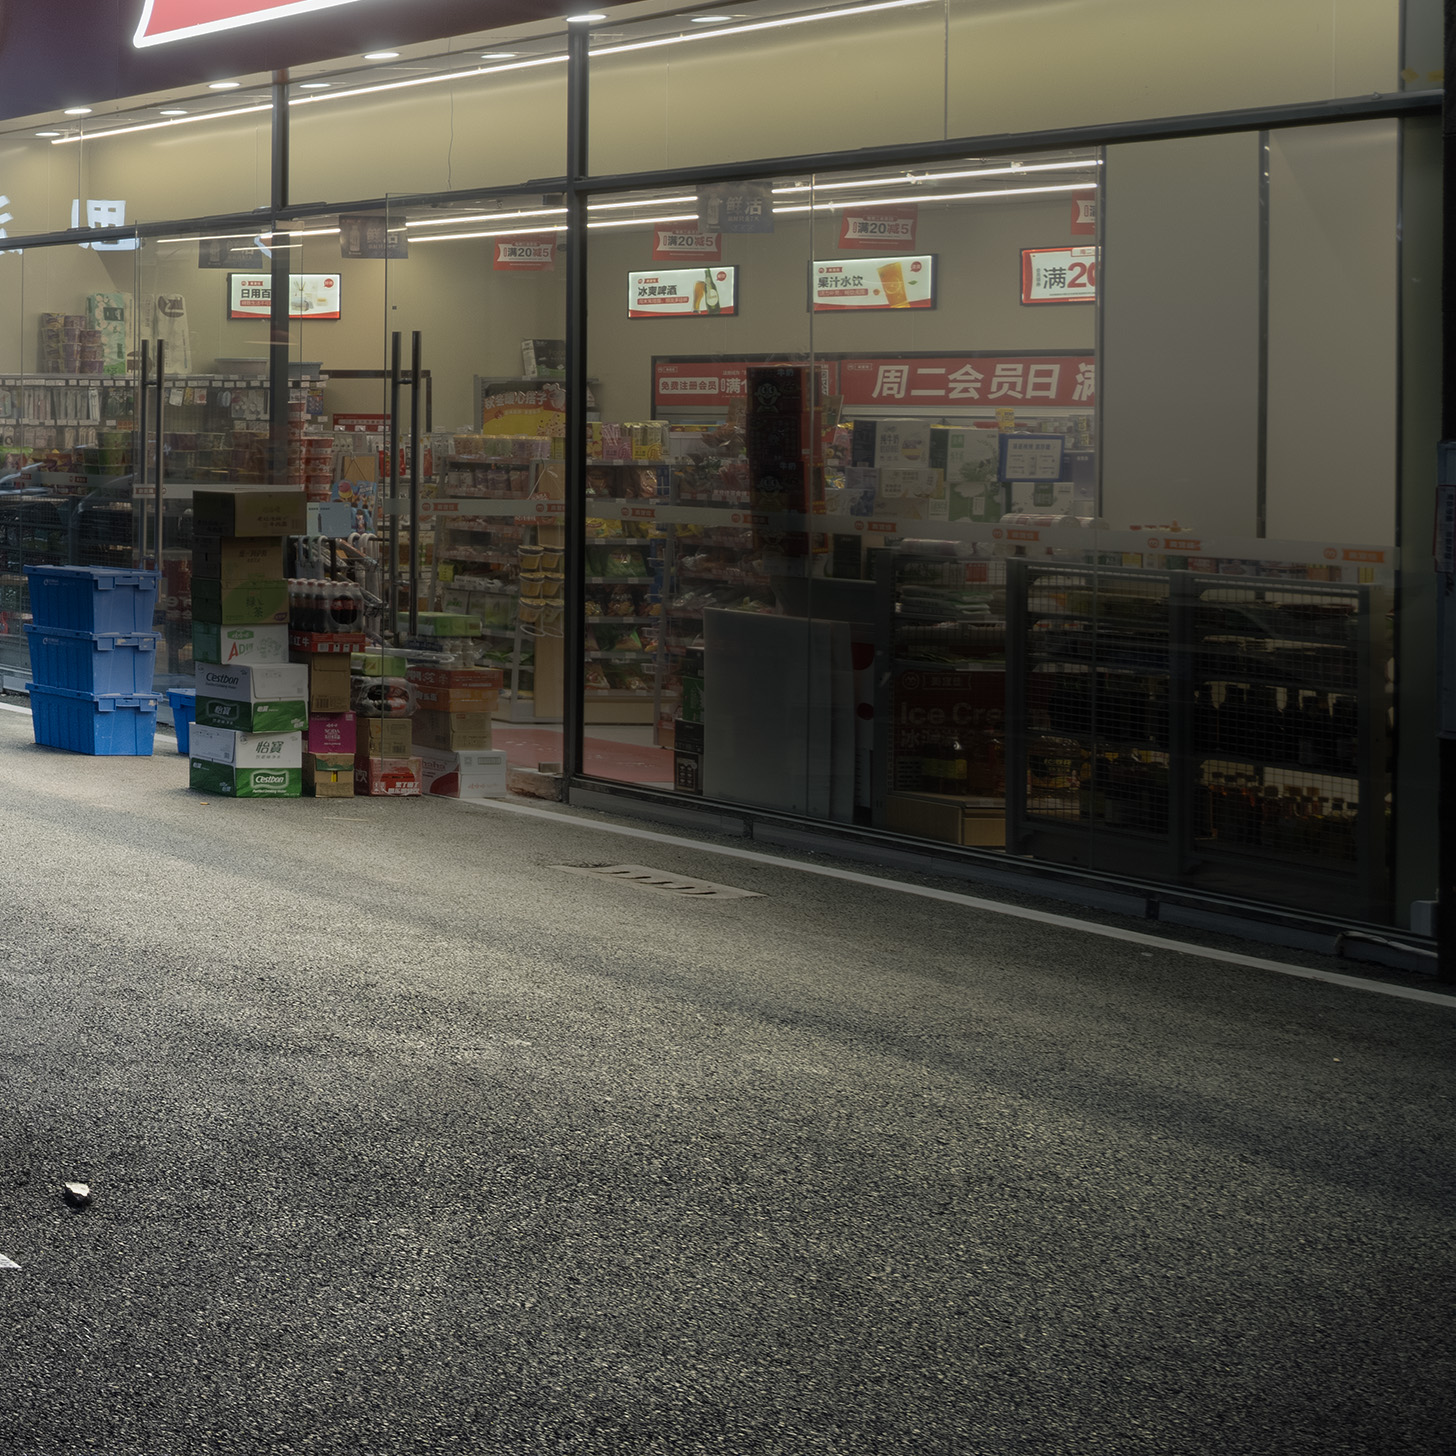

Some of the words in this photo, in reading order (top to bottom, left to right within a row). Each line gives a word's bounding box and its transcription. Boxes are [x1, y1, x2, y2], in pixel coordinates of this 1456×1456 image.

[241, 288, 271, 299] 日用百
[660, 381, 719, 395] 免费注册会员
[872, 363, 1057, 400] 周二会员日
[206, 672, 239, 686] Cestbon
[255, 772, 285, 784] Cestbon
